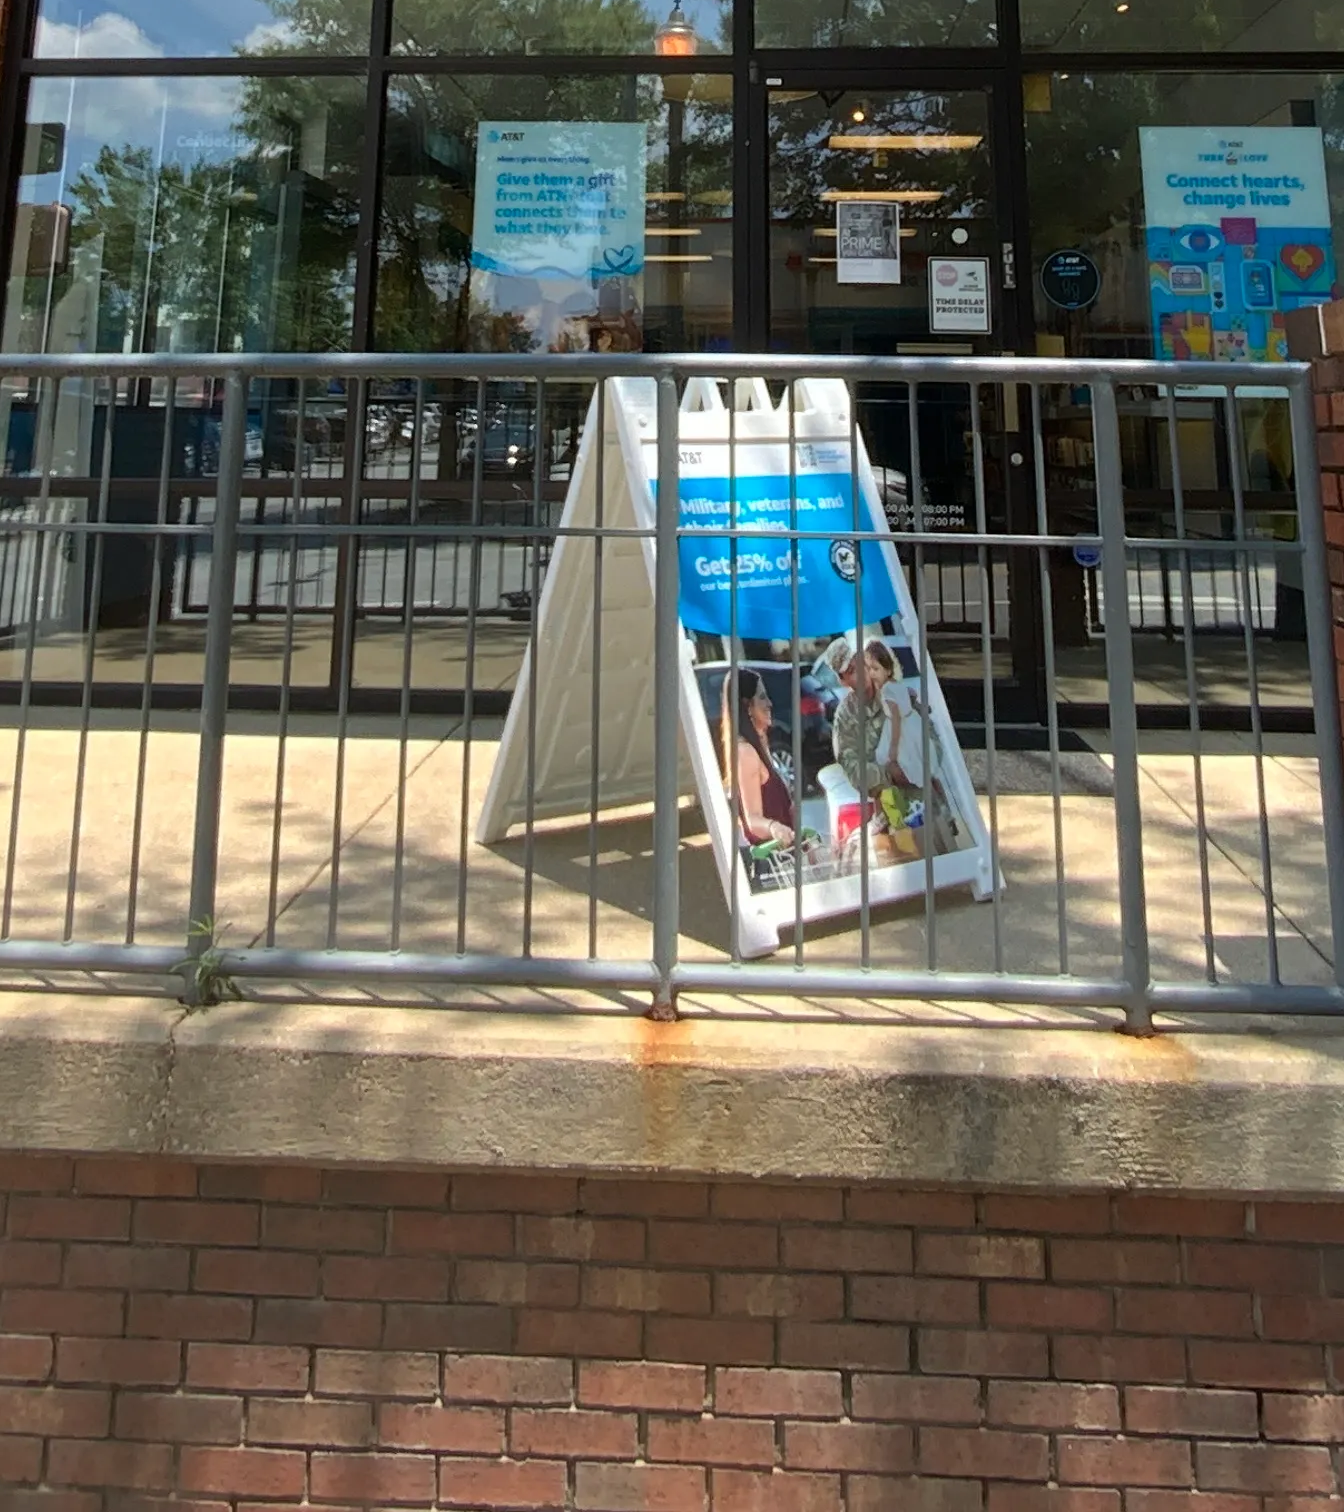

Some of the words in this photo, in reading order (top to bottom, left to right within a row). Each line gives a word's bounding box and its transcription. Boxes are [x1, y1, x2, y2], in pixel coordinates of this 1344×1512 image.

[501, 132, 524, 141] AT&T
[497, 172, 530, 185] Give
[533, 172, 573, 185] them
[576, 176, 585, 185] a
[588, 172, 615, 189] gift
[1166, 174, 1238, 188] Connect
[1242, 173, 1305, 190] hearts,
[496, 189, 533, 201] from
[1183, 191, 1245, 209] change
[1250, 190, 1291, 206] lives
[495, 207, 563, 218] connects
[495, 222, 533, 234] what
[536, 223, 571, 237] they
[842, 237, 883, 250] PRIME
[1002, 243, 1016, 289] PULL
[936, 298, 956, 306] TIME
[958, 298, 985, 306] DELAY
[936, 306, 985, 314] PROTECTED
[746, 498, 816, 512] veterns,
[817, 492, 844, 508] and
[949, 505, 964, 513] PM
[949, 517, 965, 526] PM
[695, 556, 731, 576] Get
